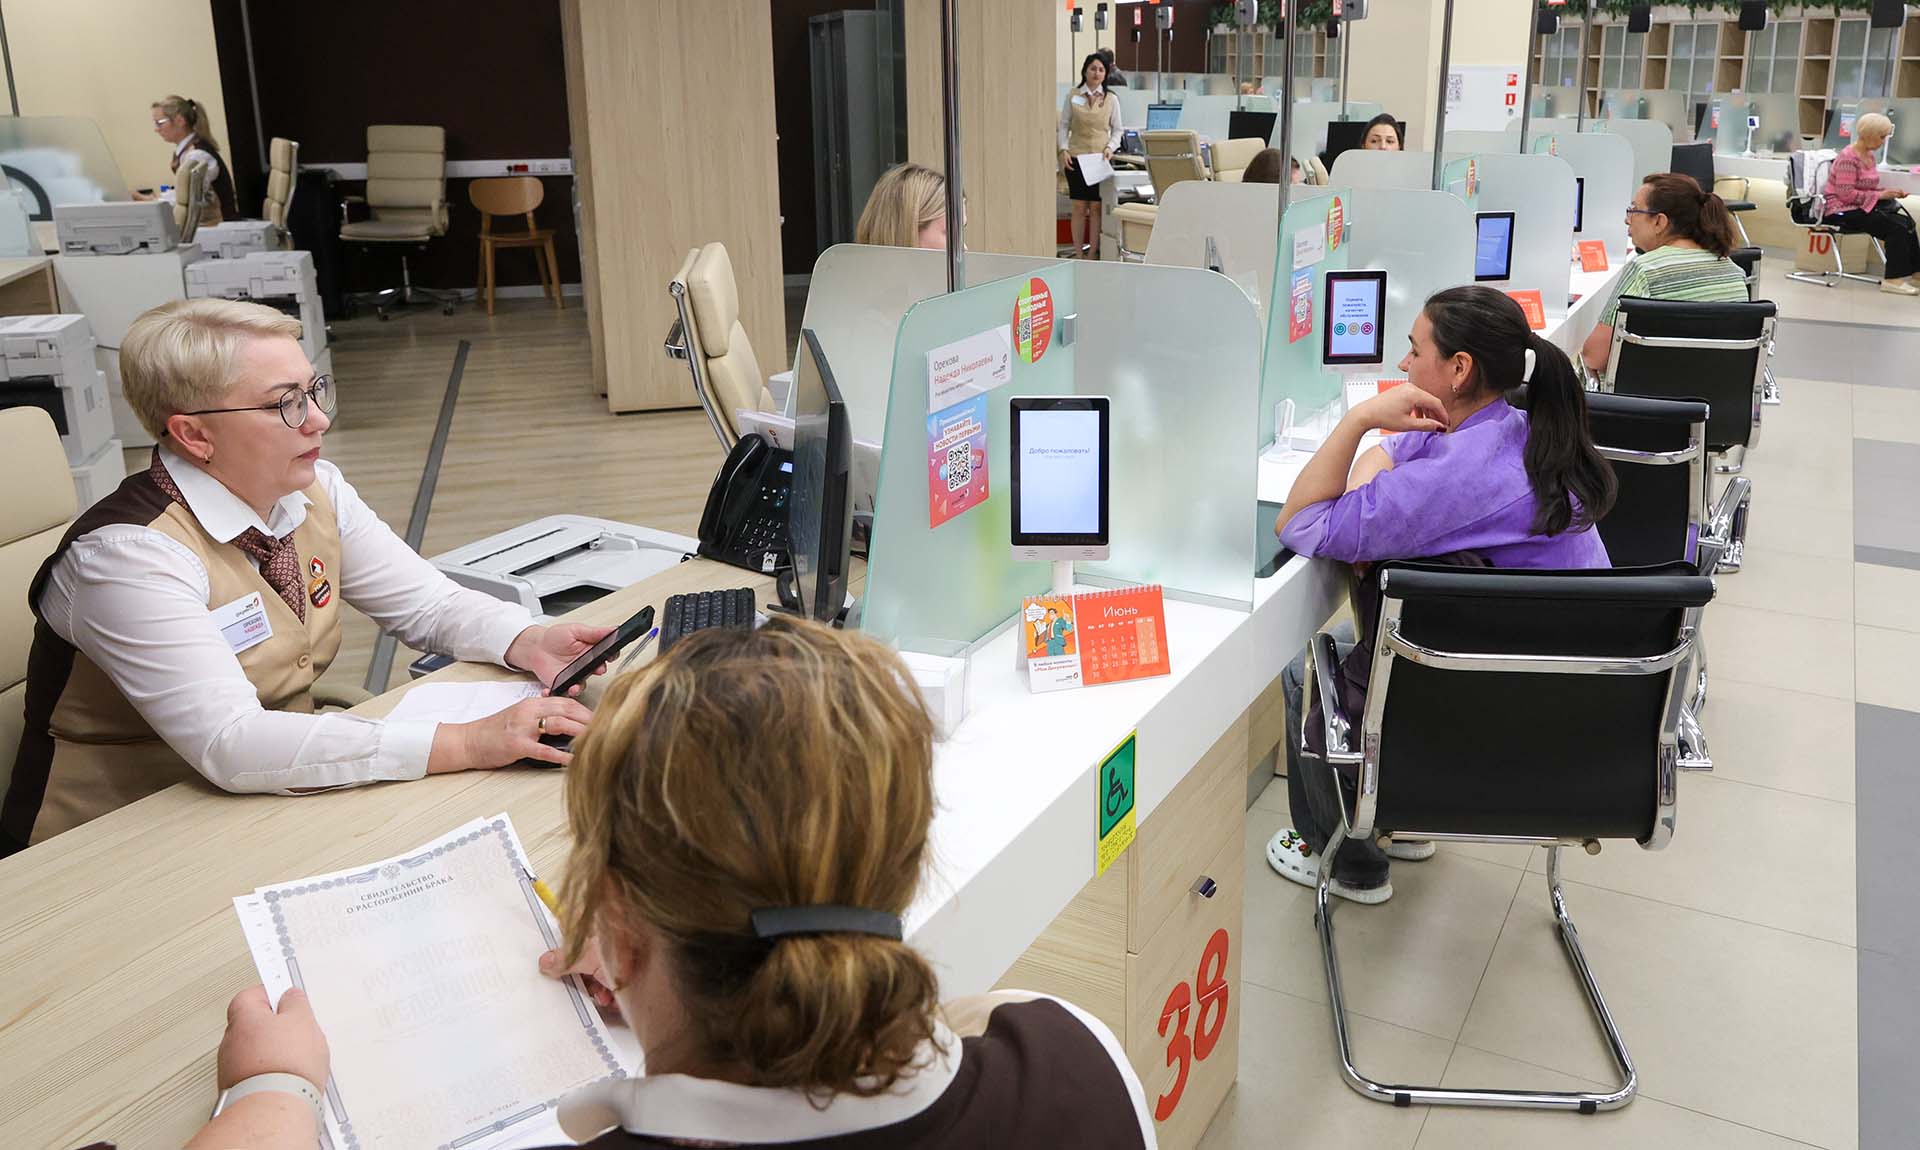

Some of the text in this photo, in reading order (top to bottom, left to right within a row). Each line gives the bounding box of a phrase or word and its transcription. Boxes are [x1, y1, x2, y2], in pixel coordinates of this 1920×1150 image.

[934, 354, 959, 372] Орехова
[934, 368, 960, 385] Надежда
[944, 418, 971, 436] УЗНАВАЙТЕ
[935, 424, 981, 449] НОВОСТИ ПЕРВЫМИ
[1029, 447, 1090, 455] Добро пожаловать!
[1103, 606, 1138, 618] Июнь
[355, 886, 424, 912] РАСТОРЖЕНИИ
[424, 874, 454, 890] БРАКА
[360, 873, 434, 901] СВИДЕТЕЛЬСТВО
[1154, 927, 1230, 1122] 38
